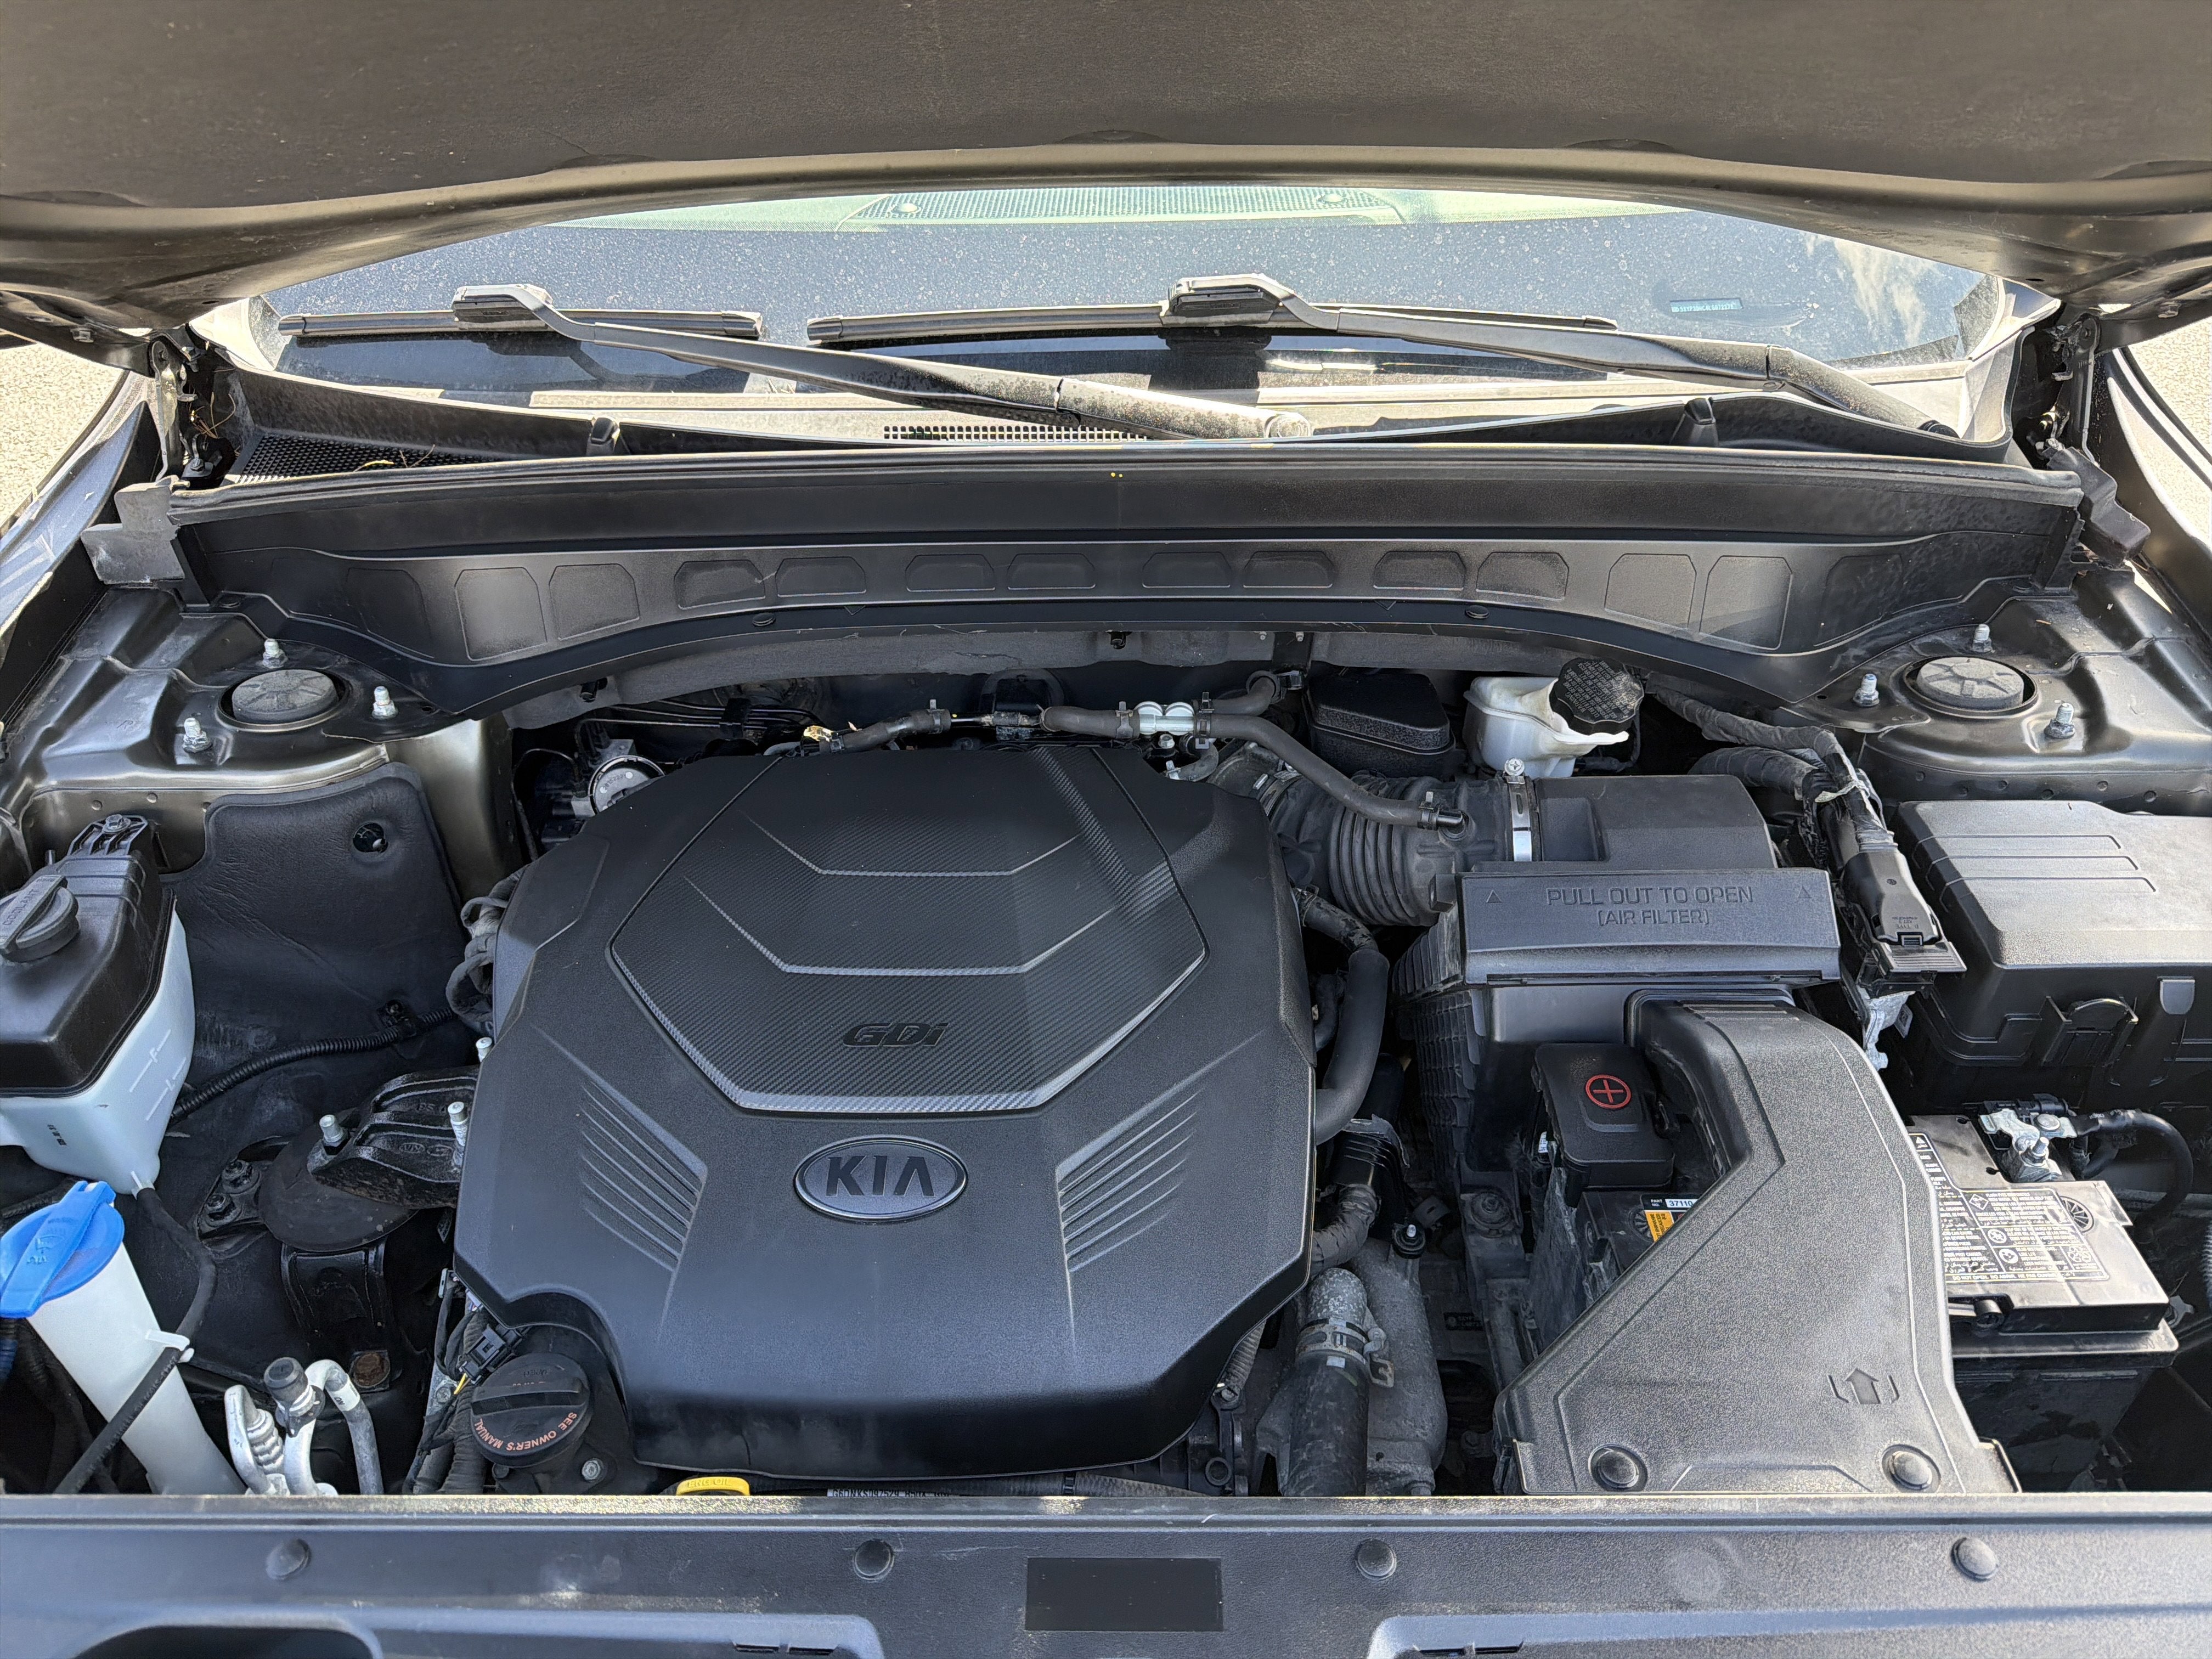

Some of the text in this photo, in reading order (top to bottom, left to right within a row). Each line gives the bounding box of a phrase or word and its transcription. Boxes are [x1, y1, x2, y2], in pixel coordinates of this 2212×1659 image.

[1564, 691, 1587, 713] WARNING
[1546, 885, 1753, 905] PULL OUT TO OPEN
[843, 1022, 950, 1047] GDi
[825, 1154, 935, 1197] KIA
[474, 1412, 577, 1451] SEE OWNER'S MANUAL
[687, 1478, 732, 1488] ENG OIL
